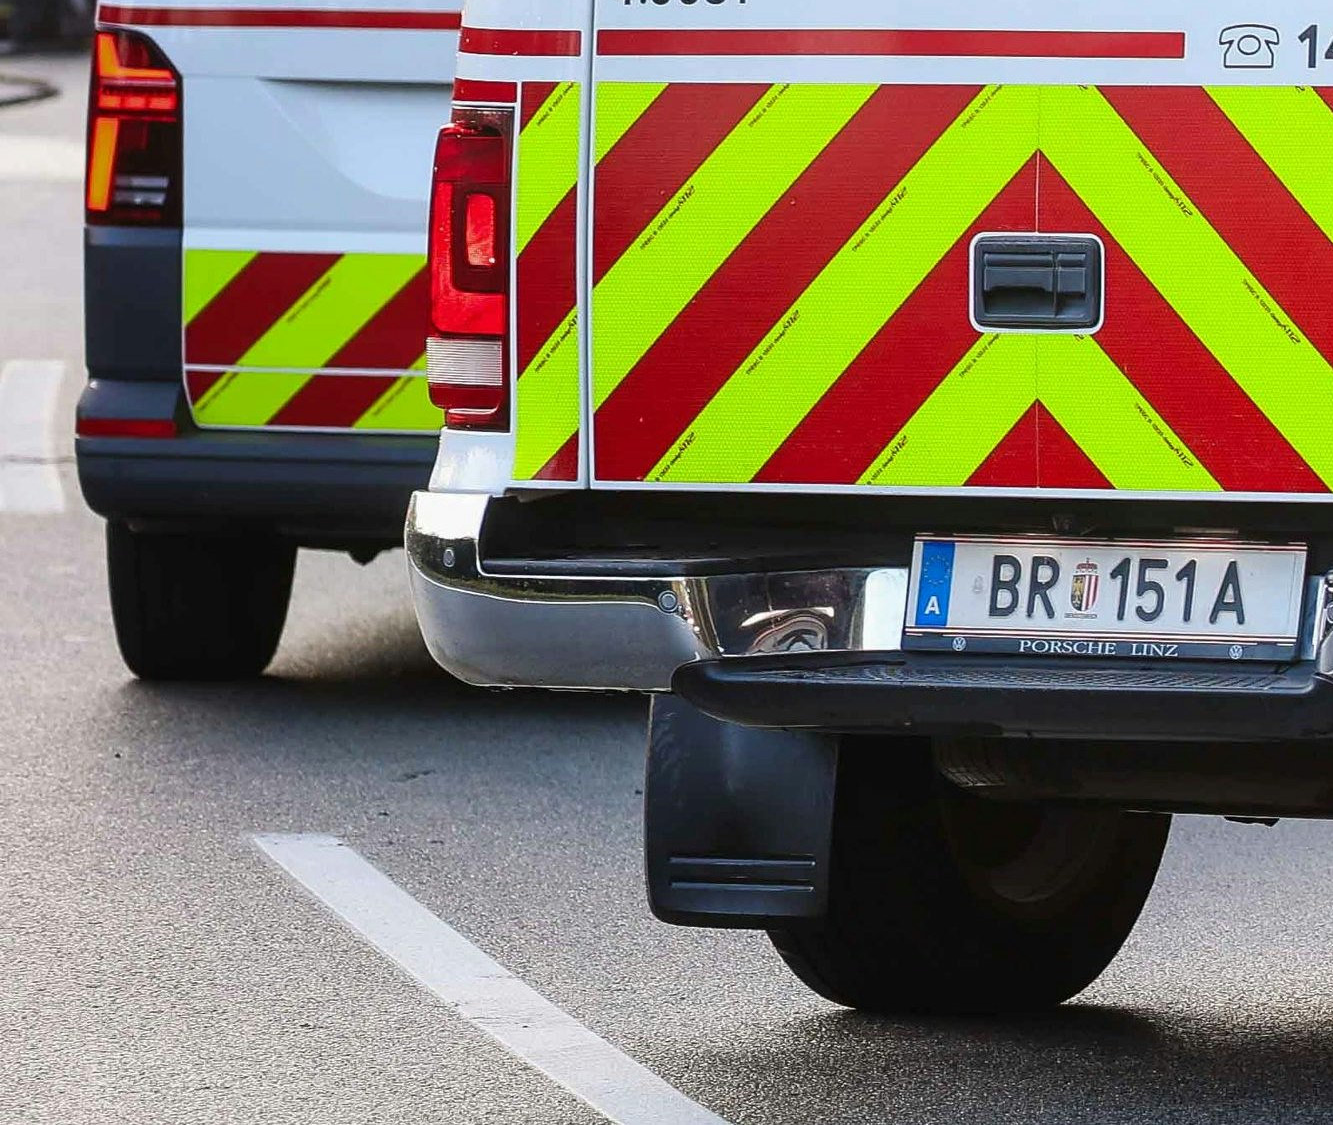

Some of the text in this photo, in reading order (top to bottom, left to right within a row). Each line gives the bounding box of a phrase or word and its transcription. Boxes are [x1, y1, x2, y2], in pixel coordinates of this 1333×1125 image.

[988, 554, 1060, 619] BR
[924, 595, 940, 615] A
[1018, 638, 1179, 658] PORSCHE LINZ
